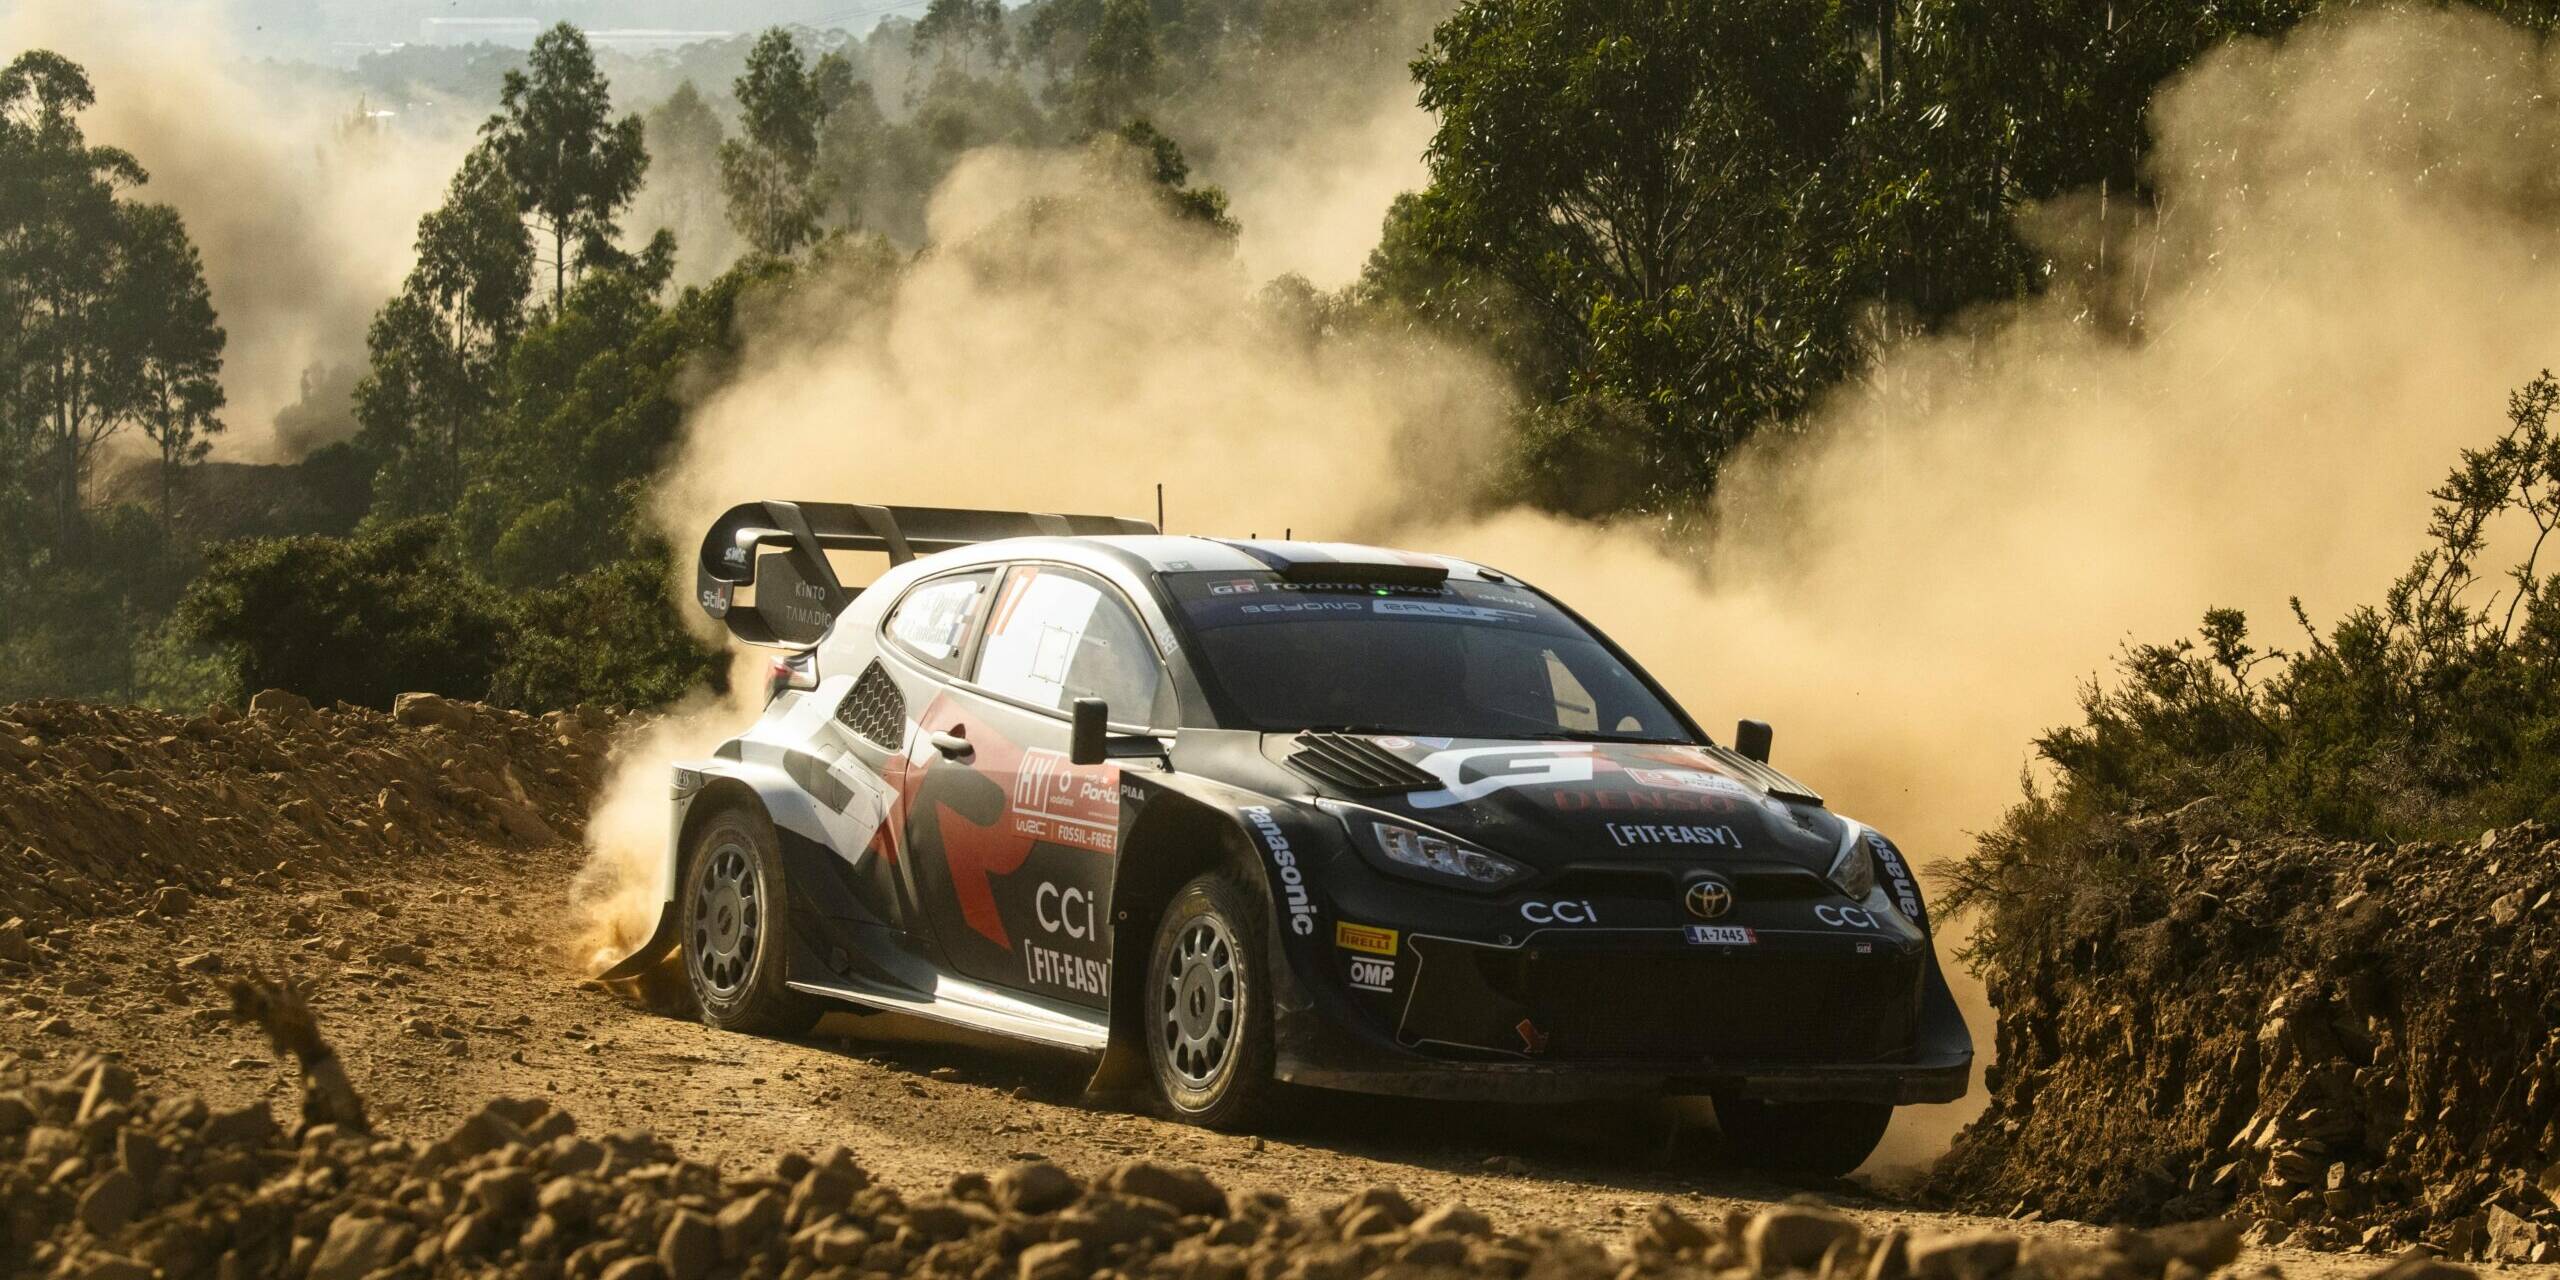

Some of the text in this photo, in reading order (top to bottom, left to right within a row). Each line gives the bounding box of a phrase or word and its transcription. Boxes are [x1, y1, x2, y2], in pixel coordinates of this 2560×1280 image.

[795, 582, 826, 601] KINTO
[1264, 582, 1363, 591] TOYOTA
[702, 588, 727, 611] Stilo
[1241, 602, 1477, 616] BEYOND RALLY
[786, 605, 832, 628] TAMADIC
[1120, 784, 1145, 801] PIAA
[1058, 824, 1112, 849] FOSSIL-FREE
[1239, 805, 1318, 936] Panasonic
[1340, 927, 1393, 950] PIRELLI
[1700, 928, 1744, 942] A-7445
[1350, 962, 1395, 986] OMP
